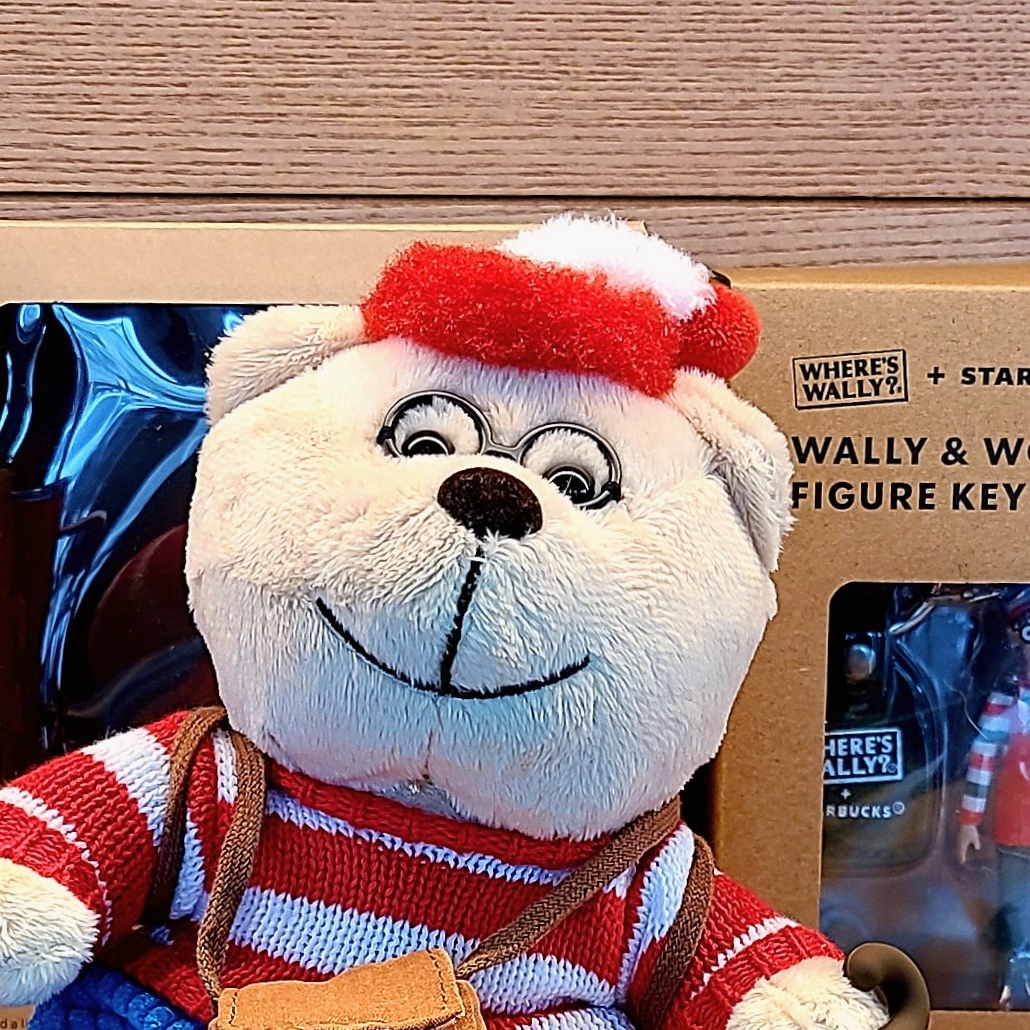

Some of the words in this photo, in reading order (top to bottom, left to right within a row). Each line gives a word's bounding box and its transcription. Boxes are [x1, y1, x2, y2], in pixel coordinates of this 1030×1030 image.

[799, 356, 900, 381] WHERE'S
[927, 367, 946, 386] +
[802, 376, 898, 402] WALLY?
[791, 436, 928, 466] WALLY
[940, 437, 970, 467] &
[983, 437, 1030, 467] W
[792, 481, 937, 511] FIGURE
[952, 483, 1027, 511] KEY
[11, 1020, 18, 1030] a
